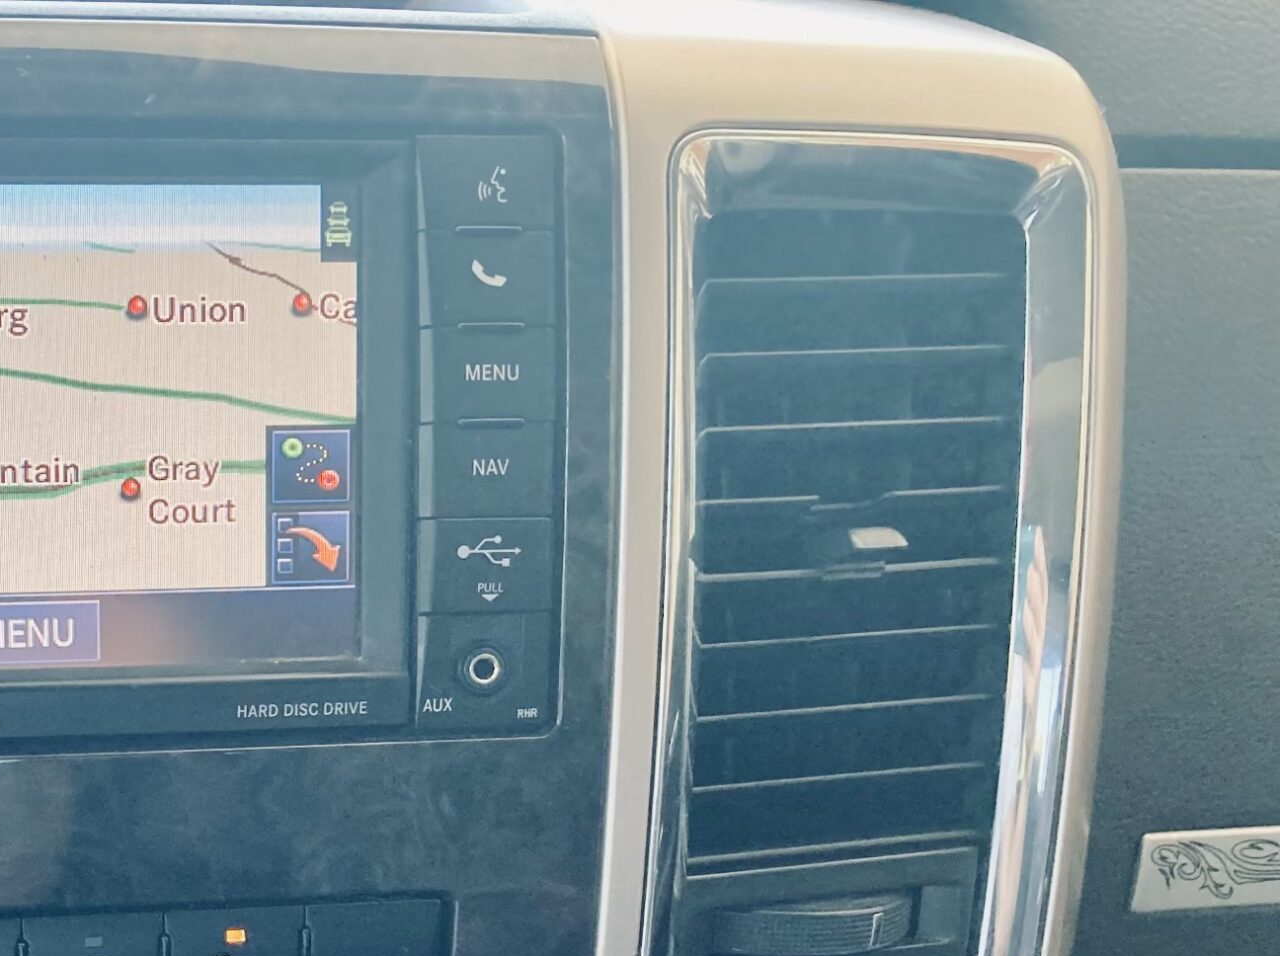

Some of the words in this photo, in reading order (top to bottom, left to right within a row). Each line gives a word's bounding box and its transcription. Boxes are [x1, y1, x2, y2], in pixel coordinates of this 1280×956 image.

[153, 297, 246, 323] Union
[465, 364, 520, 381] MENU
[148, 456, 219, 483] Gray
[472, 459, 509, 476] NAV
[148, 499, 236, 524] Court
[477, 583, 504, 593] PULL
[236, 703, 279, 718] HARD
[284, 702, 319, 717] DISC
[323, 700, 368, 716] DRIVE
[423, 698, 452, 712] AUX
